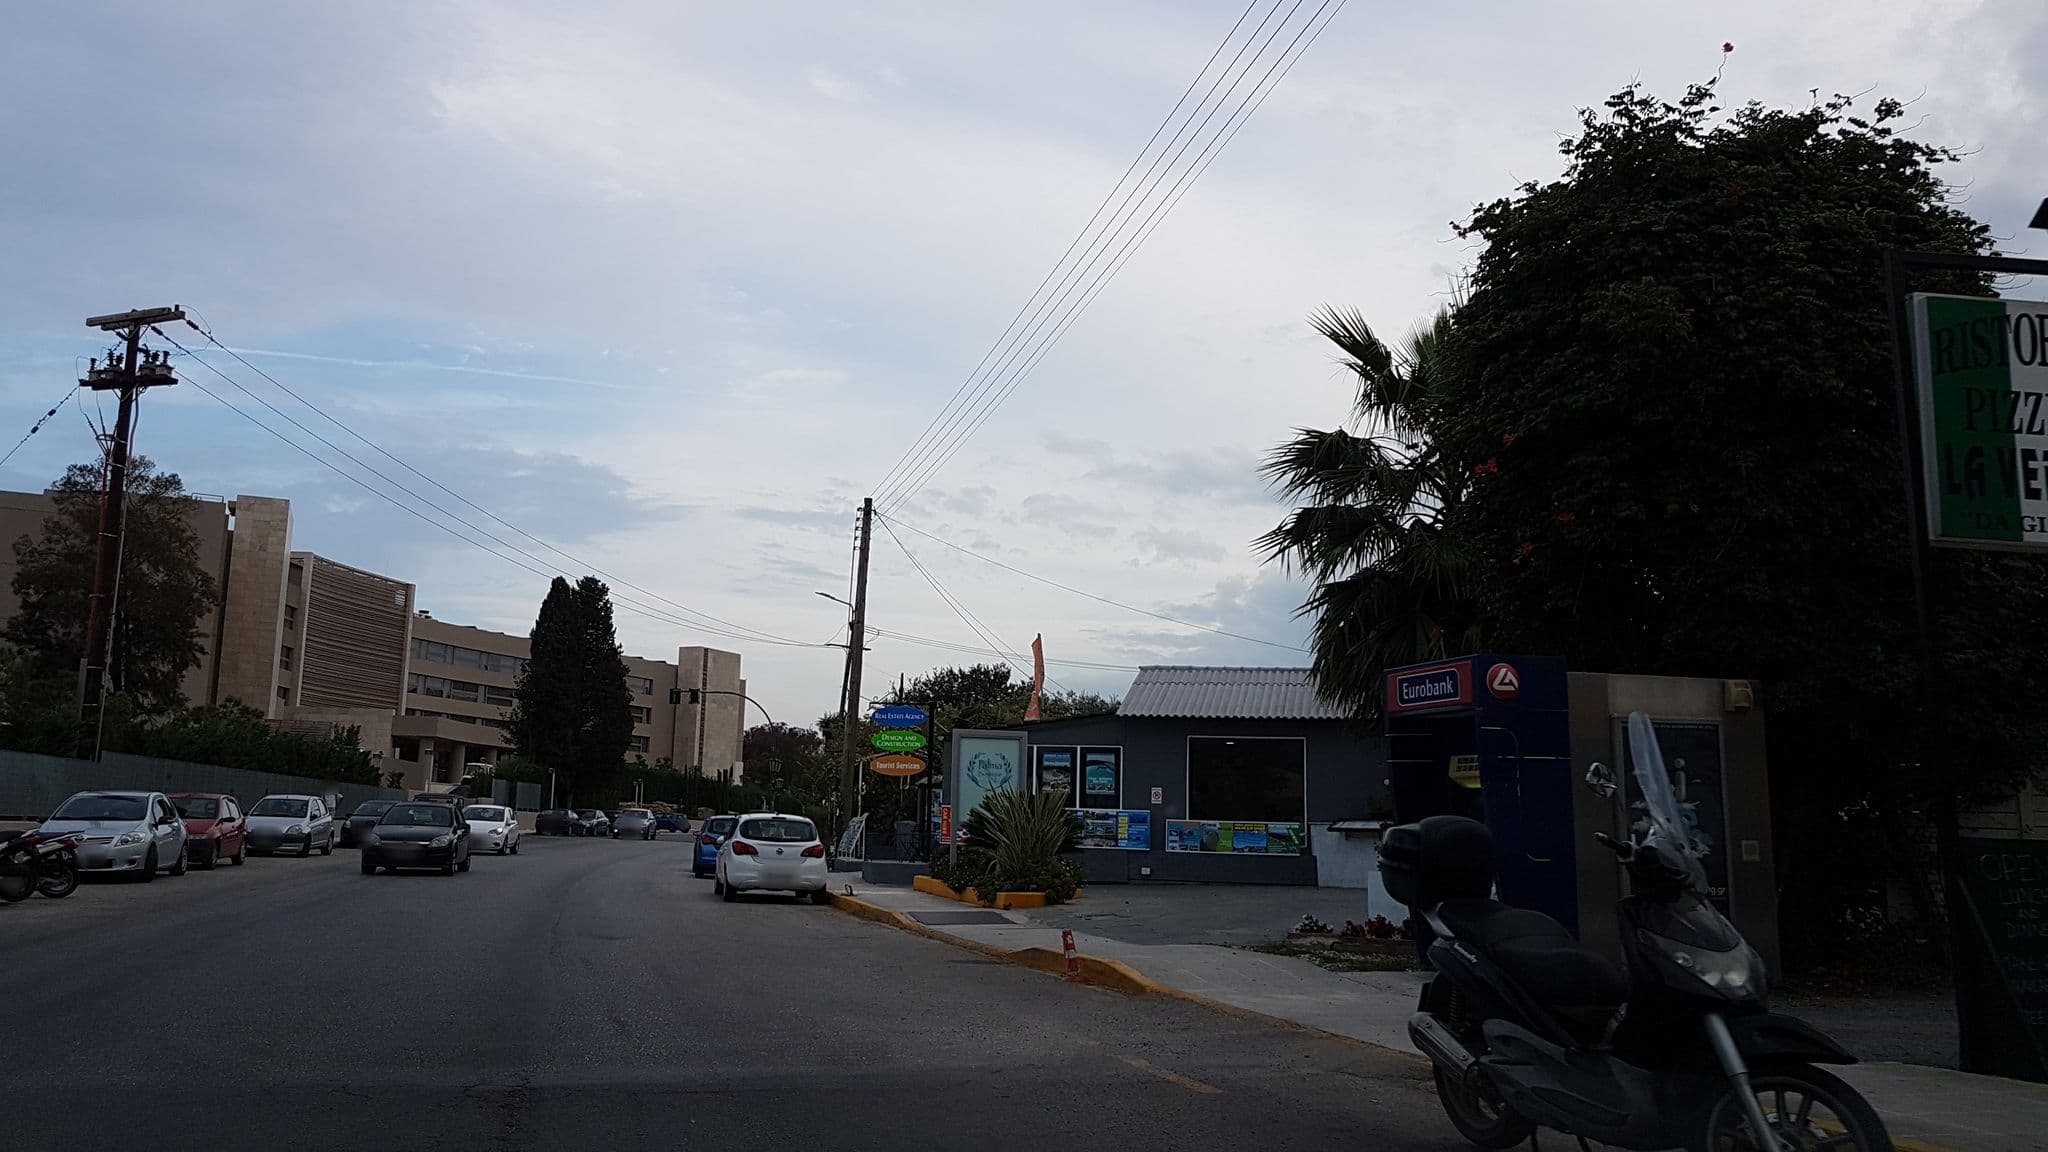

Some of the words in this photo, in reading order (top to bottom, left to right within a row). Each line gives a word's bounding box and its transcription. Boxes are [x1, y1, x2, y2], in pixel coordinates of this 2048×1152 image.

[1962, 387, 2048, 435] PIZZ
[1997, 446, 2048, 501] VE
[1403, 675, 1454, 700] Eurobank
